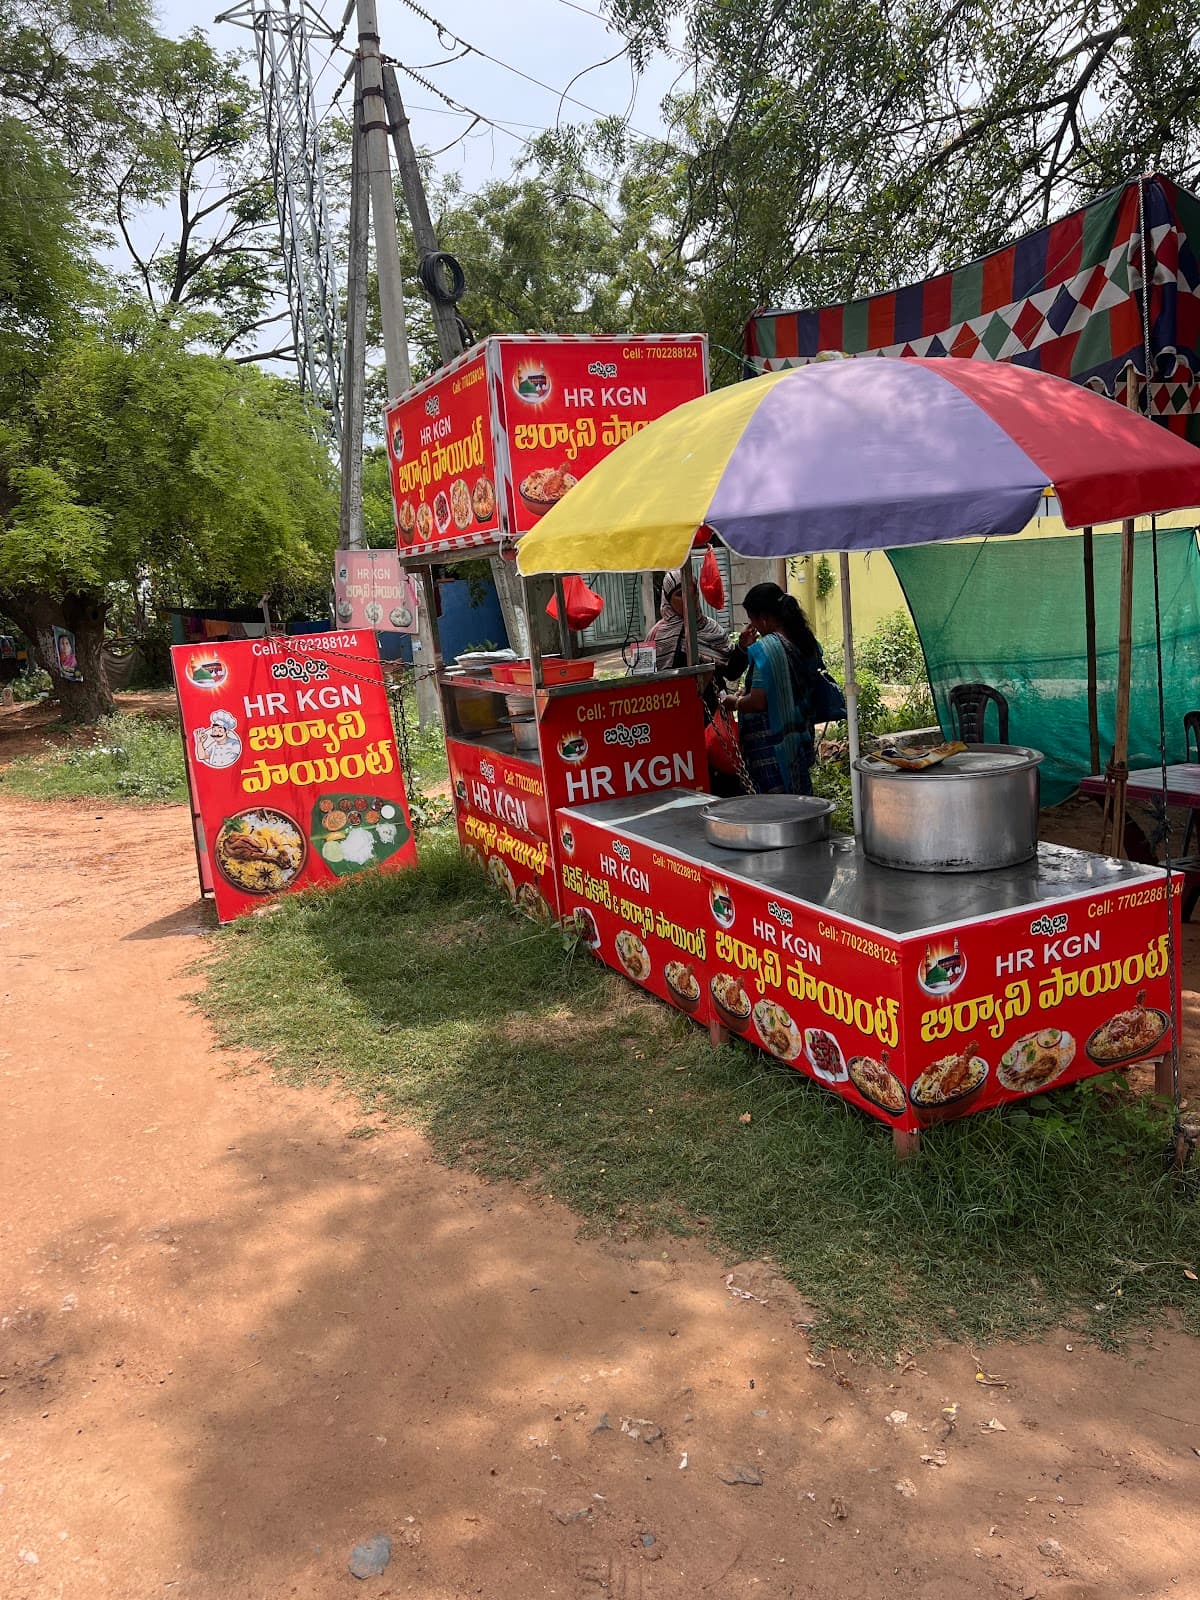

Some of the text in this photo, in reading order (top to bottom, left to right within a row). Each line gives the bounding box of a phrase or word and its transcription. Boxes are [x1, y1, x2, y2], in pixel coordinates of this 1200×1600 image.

[622, 347, 697, 359] Cell: 7702288124
[563, 386, 647, 408] HR KGN
[420, 415, 452, 446] HR KGN
[514, 417, 597, 460] బిర్యాని
[357, 567, 391, 580] HR KGN
[252, 634, 358, 656] Cell: 7702288124
[271, 657, 329, 683] బిస్మిల్లా
[242, 683, 362, 718] HR KGN
[577, 691, 681, 722] Cell: 7702288124
[249, 710, 367, 754] బిర్యాని
[604, 722, 651, 748] బిస్మిల్లా
[240, 739, 394, 793] పాయింట్
[565, 750, 695, 803] HR KGN
[472, 780, 530, 832] HR KGN
[600, 853, 650, 894] HR KGN
[652, 853, 666, 869] Cell:
[1088, 899, 1114, 918] Cell:
[752, 917, 822, 966] HR KGN
[818, 921, 899, 967] Cell: 7702288124
[995, 930, 1101, 978] HR KGN
[715, 930, 900, 1048] బిర్యాని పాయింట్
[920, 933, 1170, 1043] బిర్యాని పాయింట్
